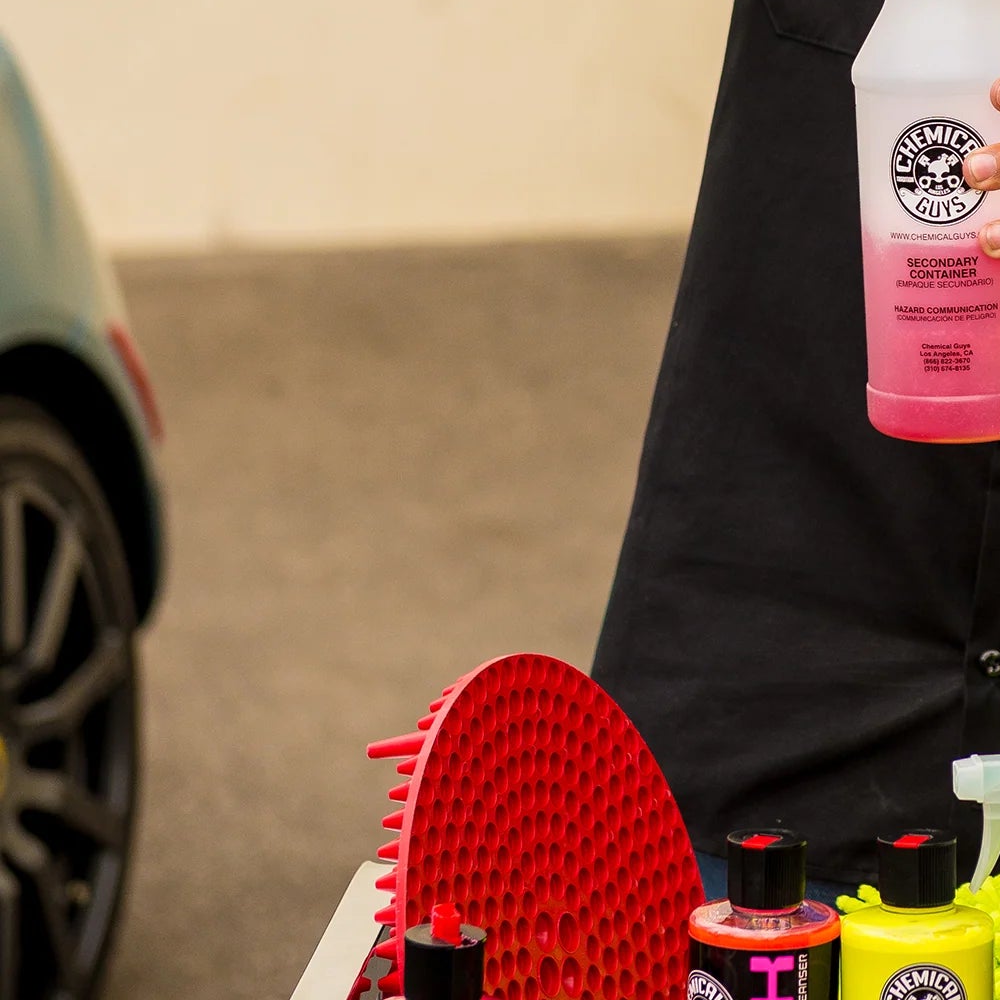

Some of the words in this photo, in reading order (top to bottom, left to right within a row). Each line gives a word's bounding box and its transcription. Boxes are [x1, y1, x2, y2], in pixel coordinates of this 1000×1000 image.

[896, 125, 979, 173] CHEMICA
[916, 196, 966, 217] GUYS
[890, 231, 980, 241] WWW.CHEMICALGUYS.
[907, 256, 979, 268] SECONDARY
[910, 268, 977, 279] CONTAINER
[896, 279, 935, 288] (EMPAQUE
[936, 278, 994, 288] SECUNDARIO)
[894, 305, 925, 314] HAZARD
[926, 303, 999, 314] COMMUNICATION
